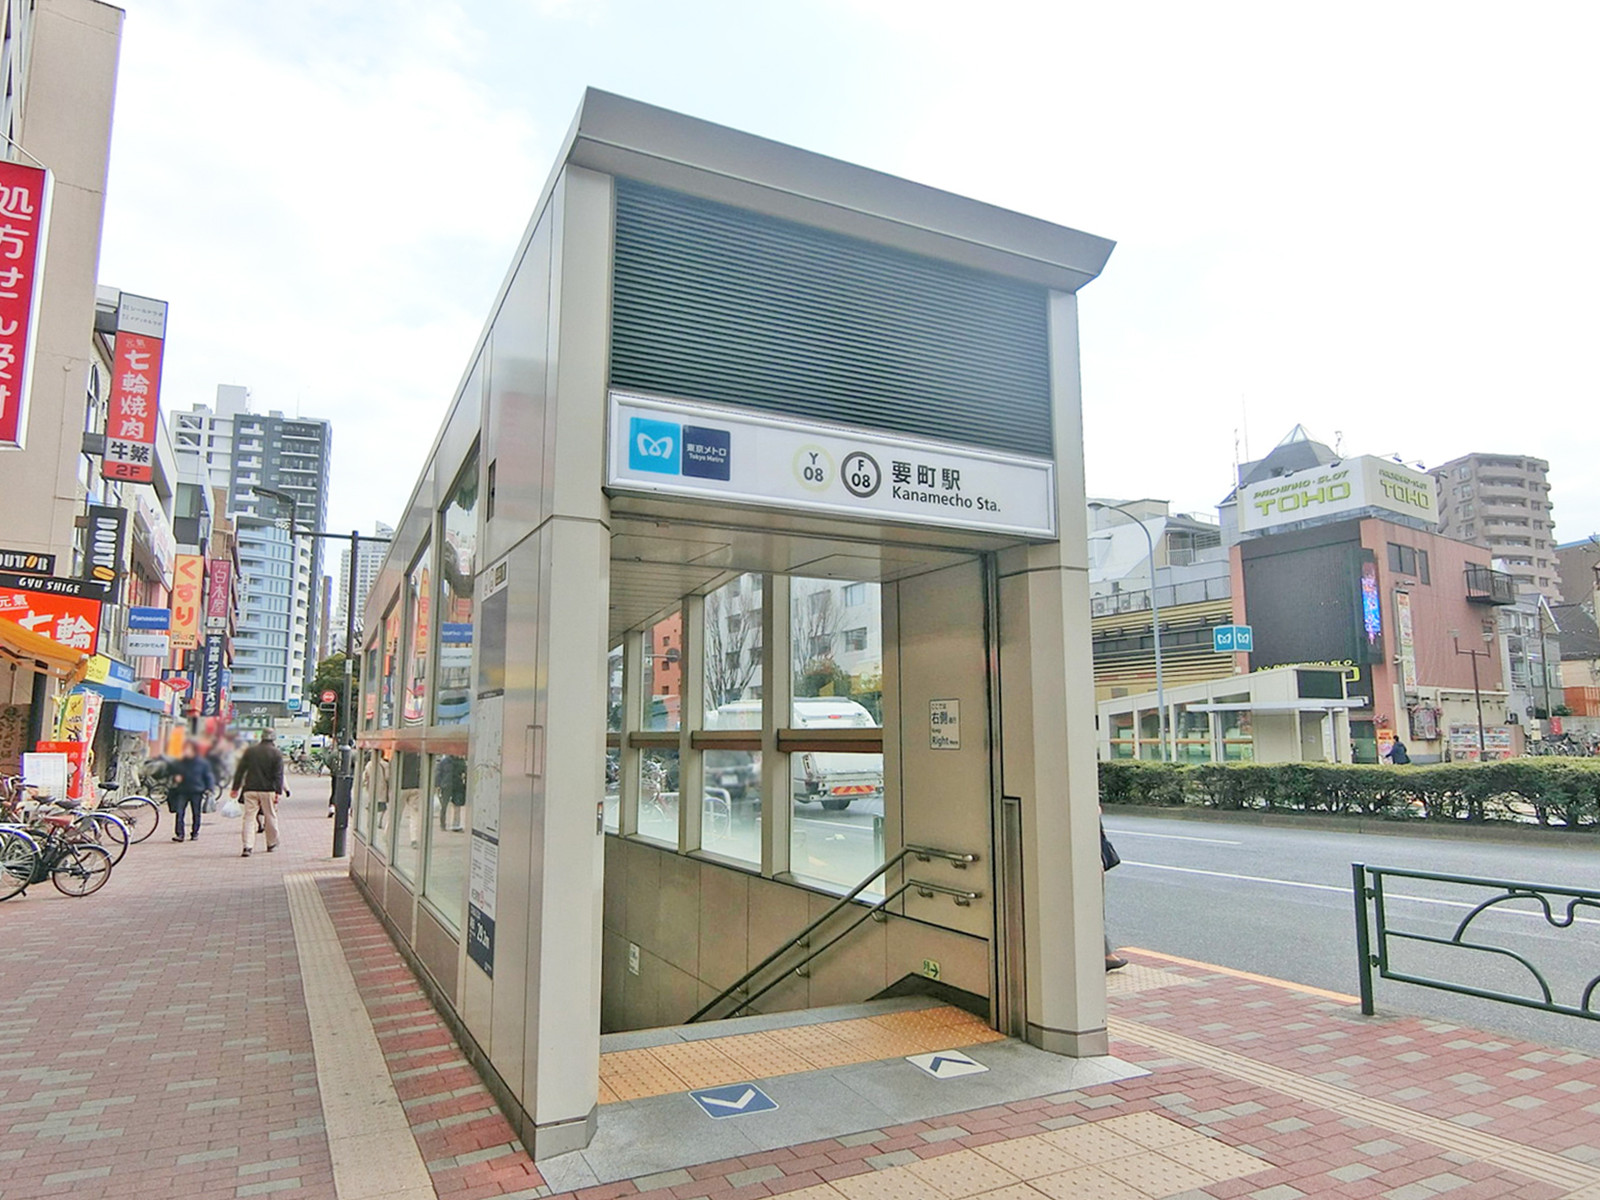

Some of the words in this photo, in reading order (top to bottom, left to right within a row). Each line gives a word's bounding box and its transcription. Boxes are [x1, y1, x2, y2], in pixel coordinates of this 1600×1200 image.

[119, 350, 151, 439] 七輪焼肉
[110, 441, 149, 462] 牛繁
[687, 443, 727, 457] 東京メトロ
[689, 452, 706, 461] Tokyo
[706, 455, 724, 463] Metro
[809, 452, 818, 465] Y
[115, 464, 141, 476] 2F
[858, 459, 864, 471] F
[803, 467, 823, 482] 08
[851, 473, 870, 488] 08
[892, 461, 960, 491] 要町駅
[892, 486, 972, 509] Kanamecho
[977, 496, 1000, 512] Sta.
[1254, 482, 1351, 516] TOHO
[1380, 478, 1430, 510] TOHO
[0, 553, 48, 571] UTOR
[19, 577, 43, 588] GYU
[47, 581, 80, 594] SHIGE
[176, 560, 197, 627] くすり
[211, 570, 227, 613] 白木屋
[131, 614, 168, 623] Panasonic
[18, 610, 95, 649] 七輪
